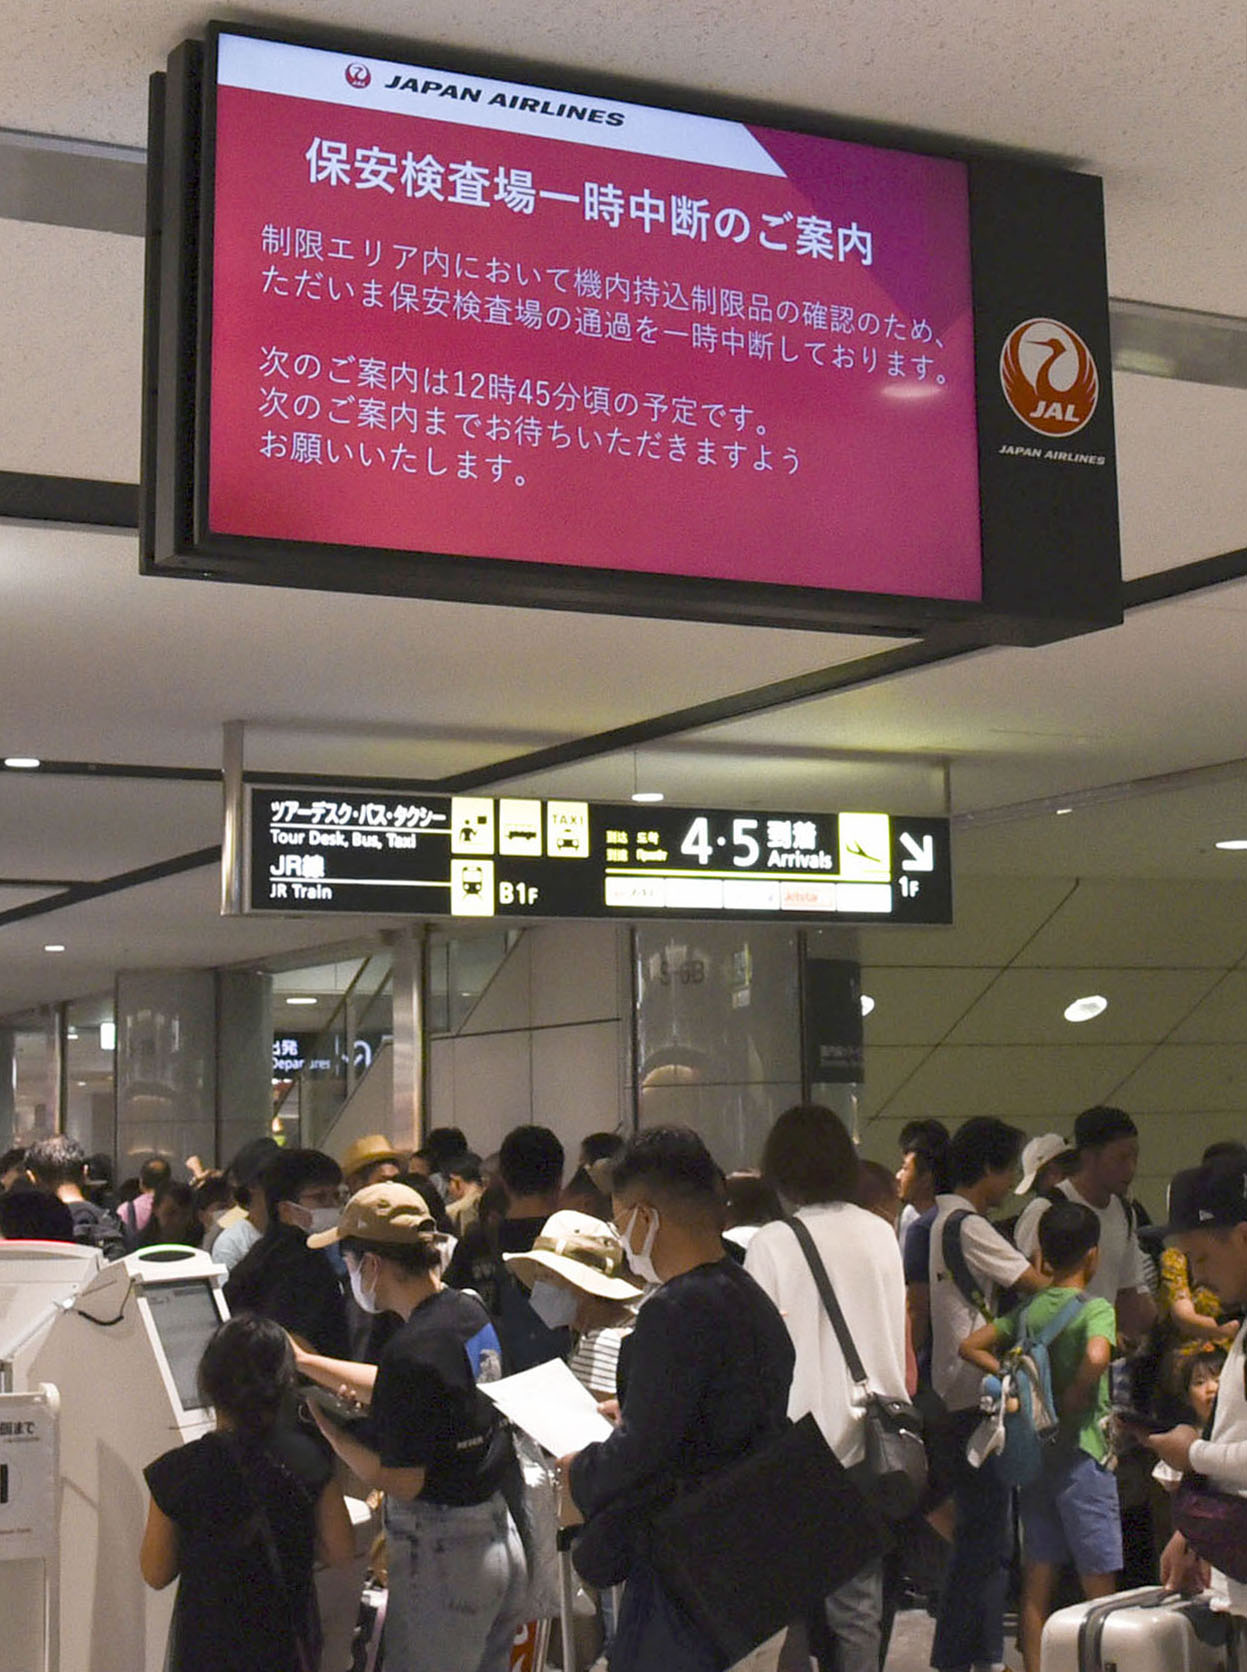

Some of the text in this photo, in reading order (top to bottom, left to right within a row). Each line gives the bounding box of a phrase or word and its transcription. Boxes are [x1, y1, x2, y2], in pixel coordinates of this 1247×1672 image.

[384, 75, 626, 127] JAPAN AIRLINES
[305, 136, 875, 267] 保安検査場一時中断のご案内
[260, 223, 945, 350] 制限エリア内において機内持込制限品の確認のため、
[261, 264, 948, 386] ただいま保安検査場の通過を一時中断しております。
[259, 345, 767, 436] 次のご案内は12時45分頃の予定です。
[1030, 400, 1080, 422] JAL
[258, 386, 800, 475] 次のご案内までお待ちいただきますよう
[259, 430, 526, 487] お願いいたします。
[998, 445, 1106, 465] JAPAN AIRLINES
[552, 814, 584, 824] TAXI
[270, 829, 417, 850] Tour Desk, Bus, Taxi
[767, 850, 833, 869] Arrivals
[269, 883, 333, 900] JR Train
[499, 881, 539, 905] B1F
[899, 876, 919, 898] 1F
[272, 1057, 331, 1073] Deparures
